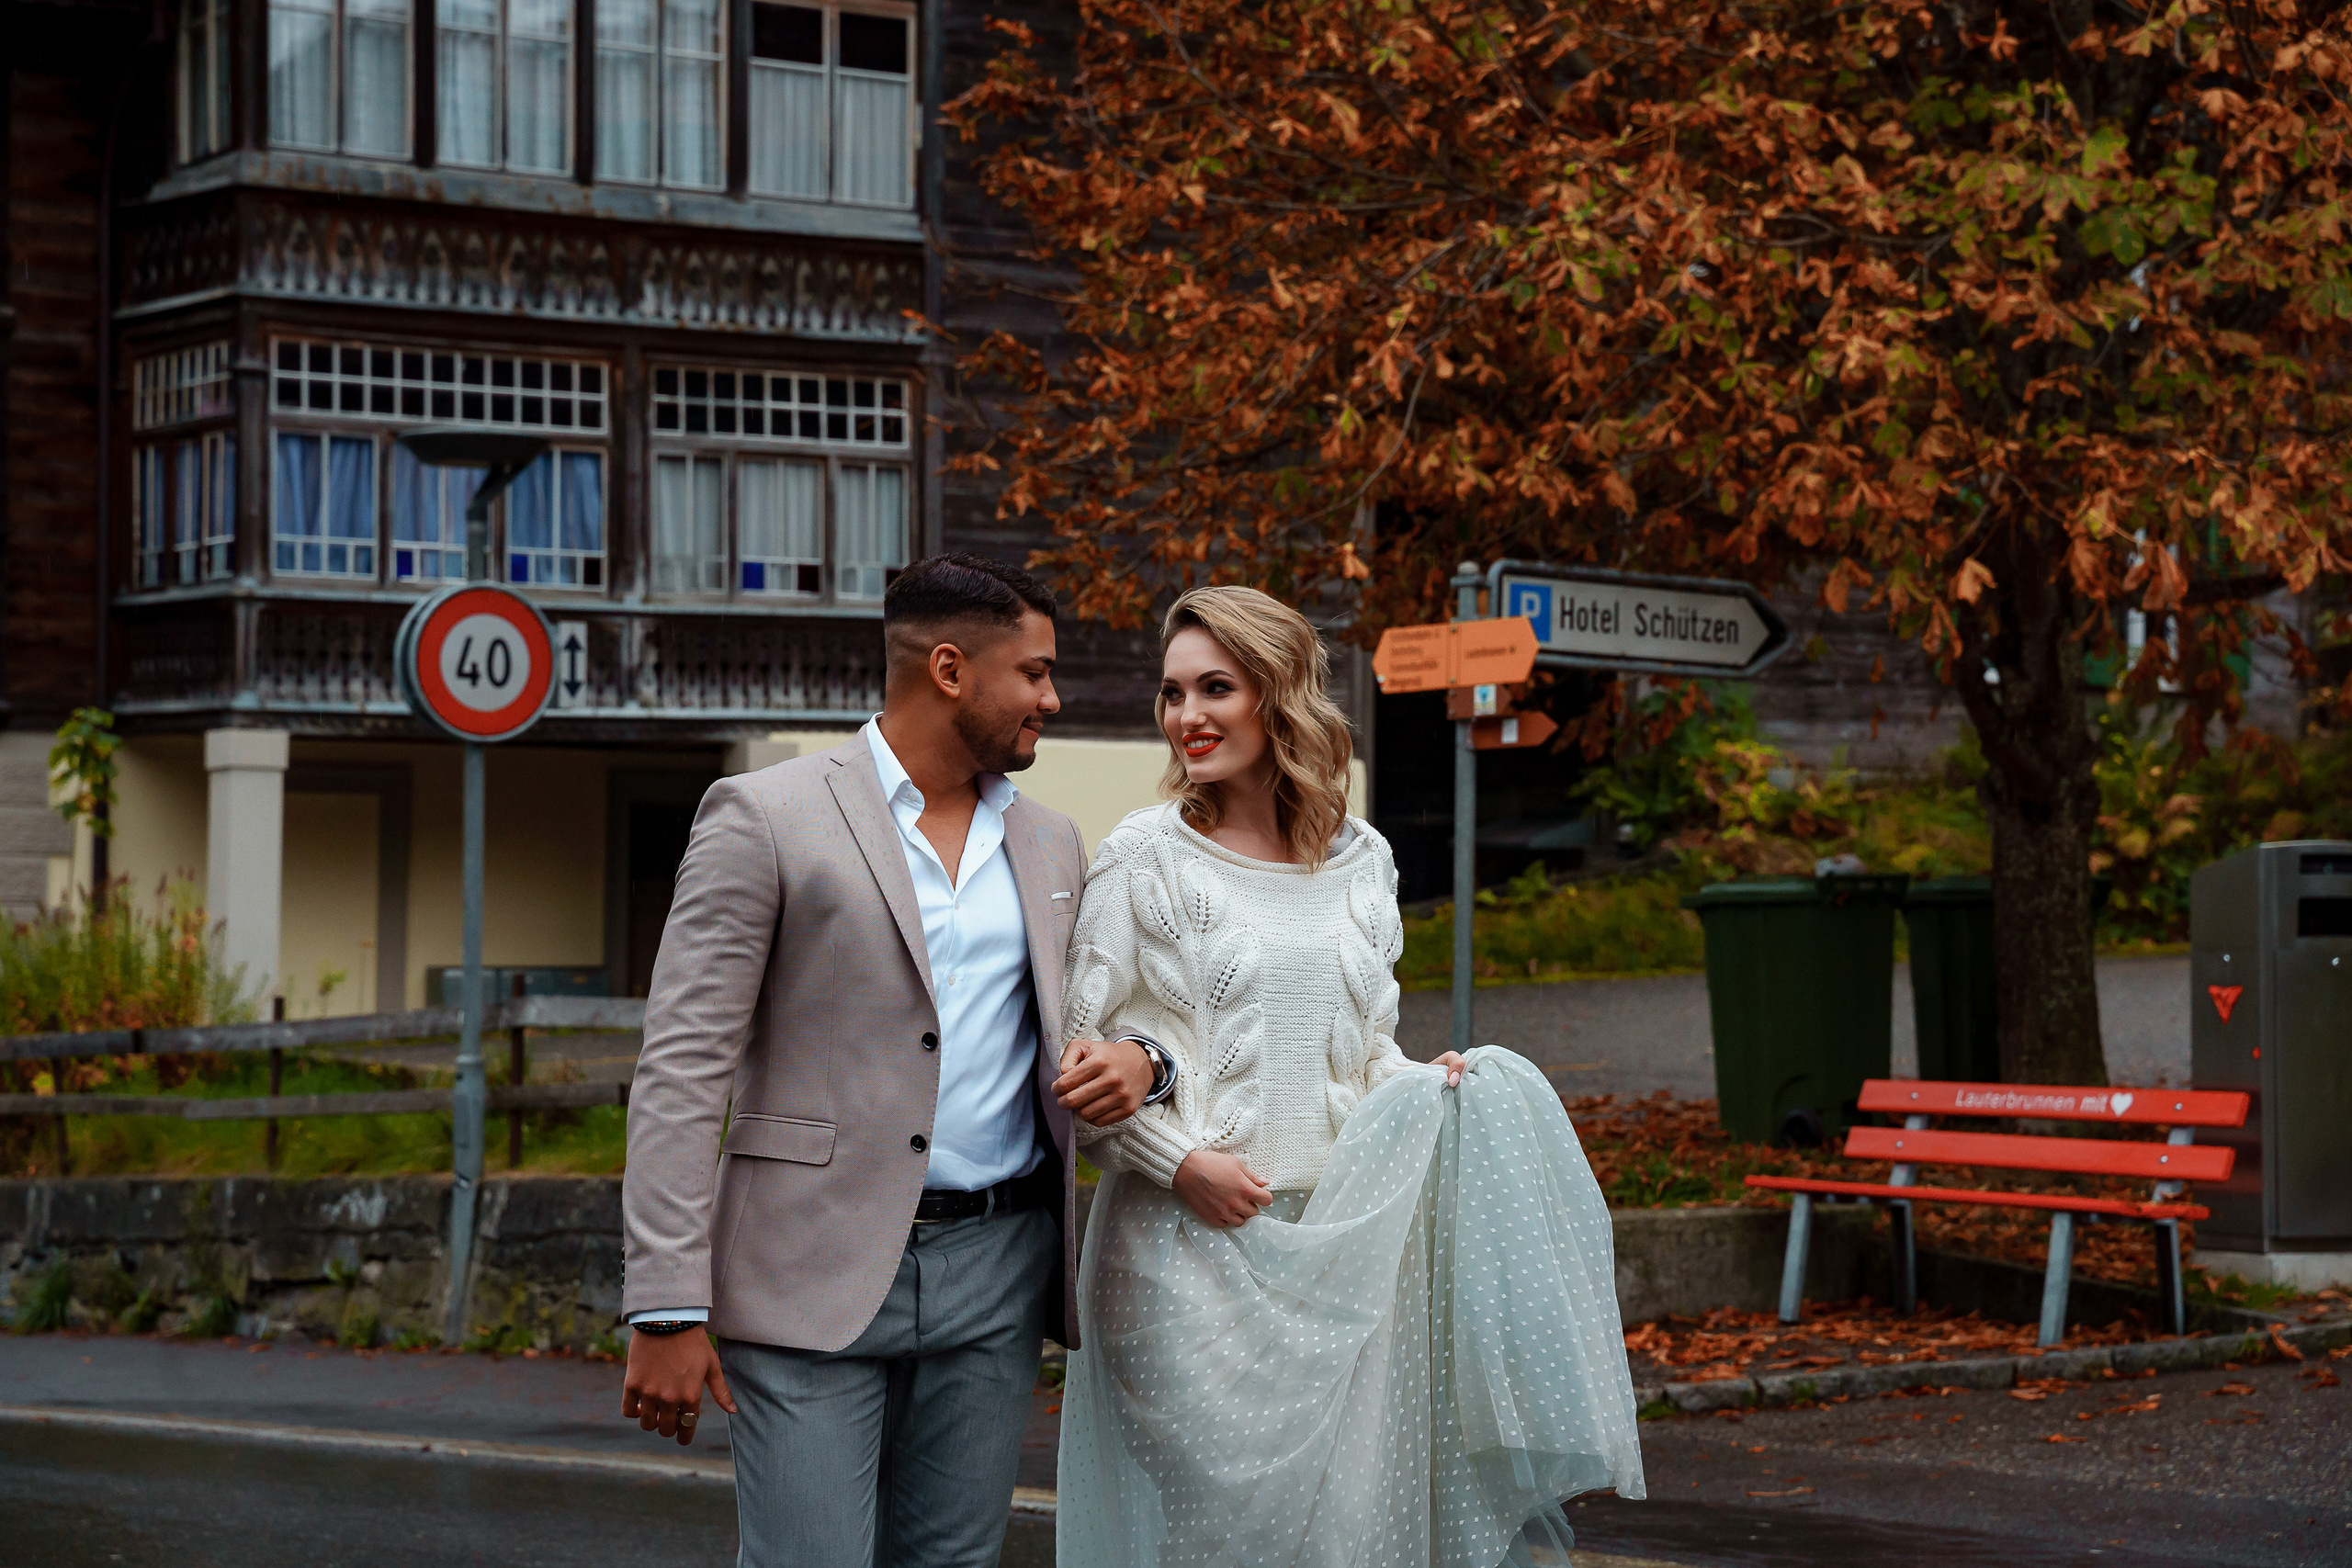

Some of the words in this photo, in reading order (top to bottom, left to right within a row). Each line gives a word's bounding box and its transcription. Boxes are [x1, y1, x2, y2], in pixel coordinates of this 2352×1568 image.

[1521, 592, 1541, 619] P
[1558, 595, 1621, 635] Hotel
[1634, 603, 1741, 645] Schützen
[457, 636, 512, 688] 40
[1954, 1089, 2075, 1111] Lauterbrunnen
[2080, 1092, 2109, 1113] mit
